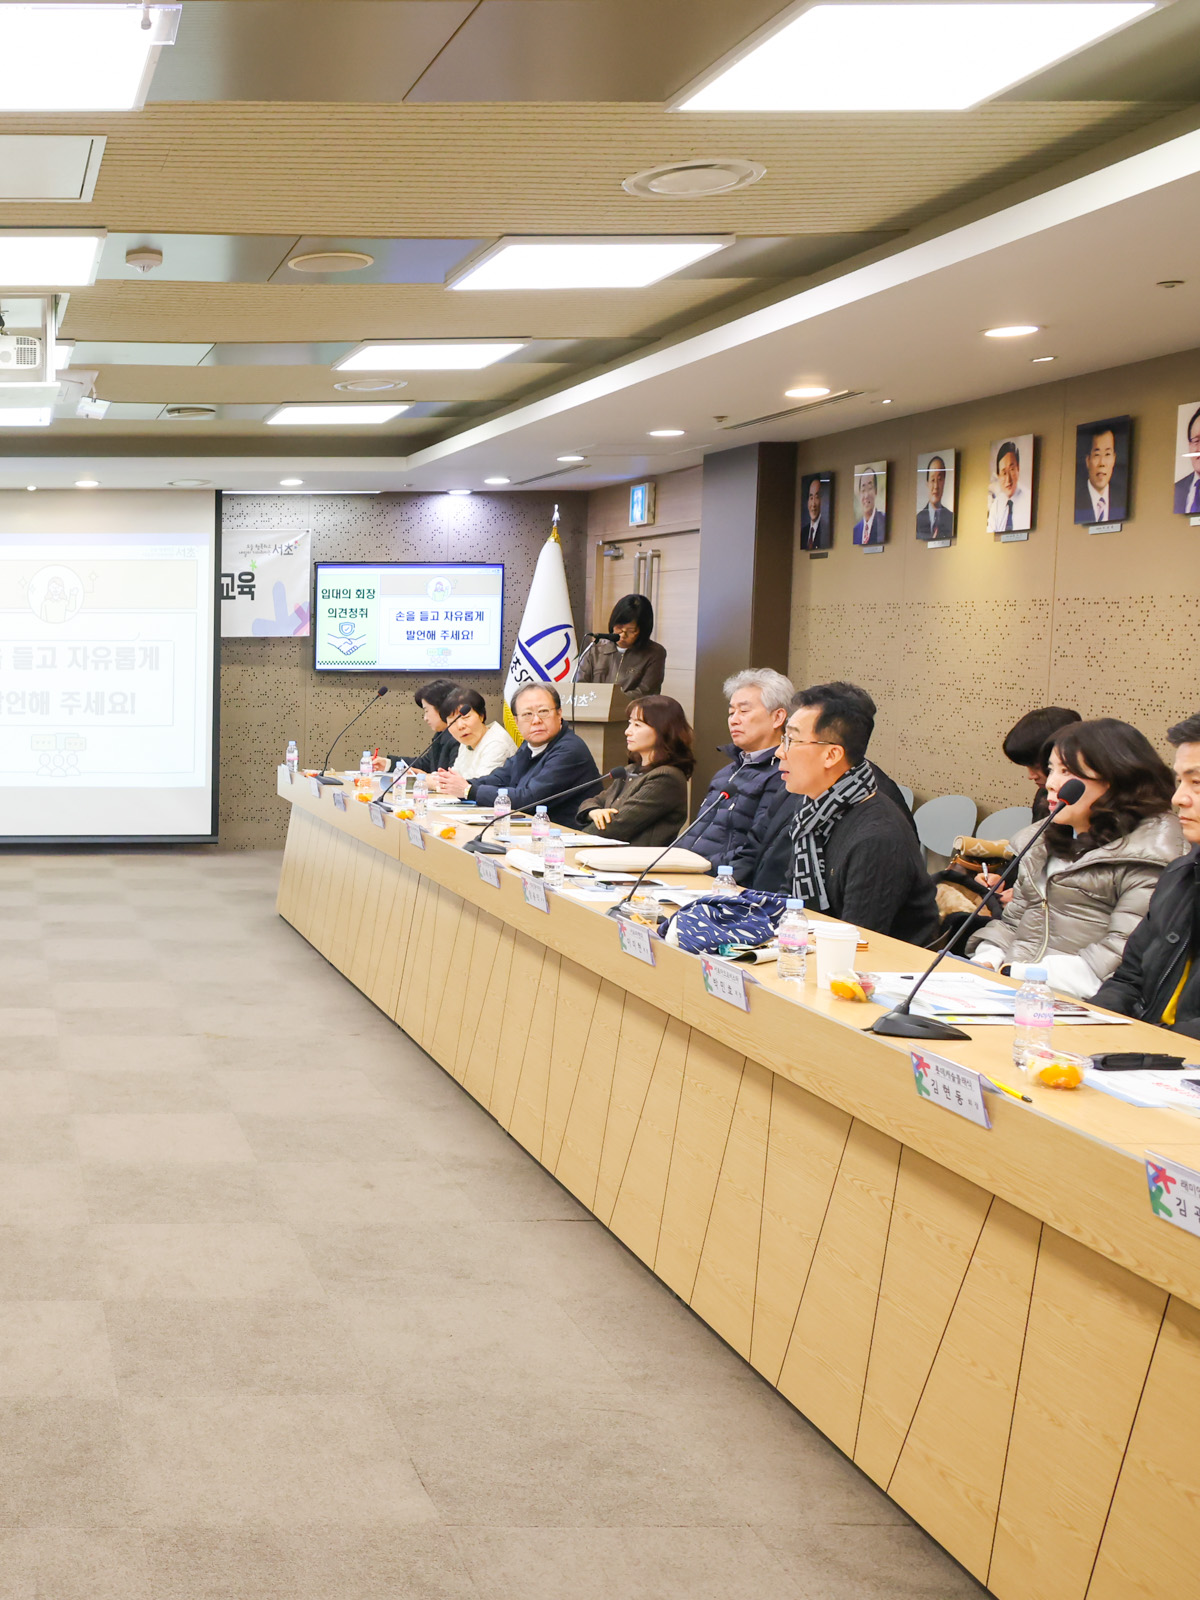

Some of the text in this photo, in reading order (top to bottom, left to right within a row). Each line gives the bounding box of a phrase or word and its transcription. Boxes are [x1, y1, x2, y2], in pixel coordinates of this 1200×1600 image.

[272, 542, 294, 556] 서초
[221, 571, 256, 601] 교육
[321, 588, 376, 600] 입대의 회장
[327, 607, 369, 619] 의견청취
[395, 610, 485, 622] 손을 들고 자유롭게
[406, 630, 474, 641] 발언해 주세요!
[11, 646, 59, 671] 들고
[67, 645, 160, 672] 자유롭게
[59, 689, 136, 716] 주세요!
[565, 694, 589, 707] 서초
